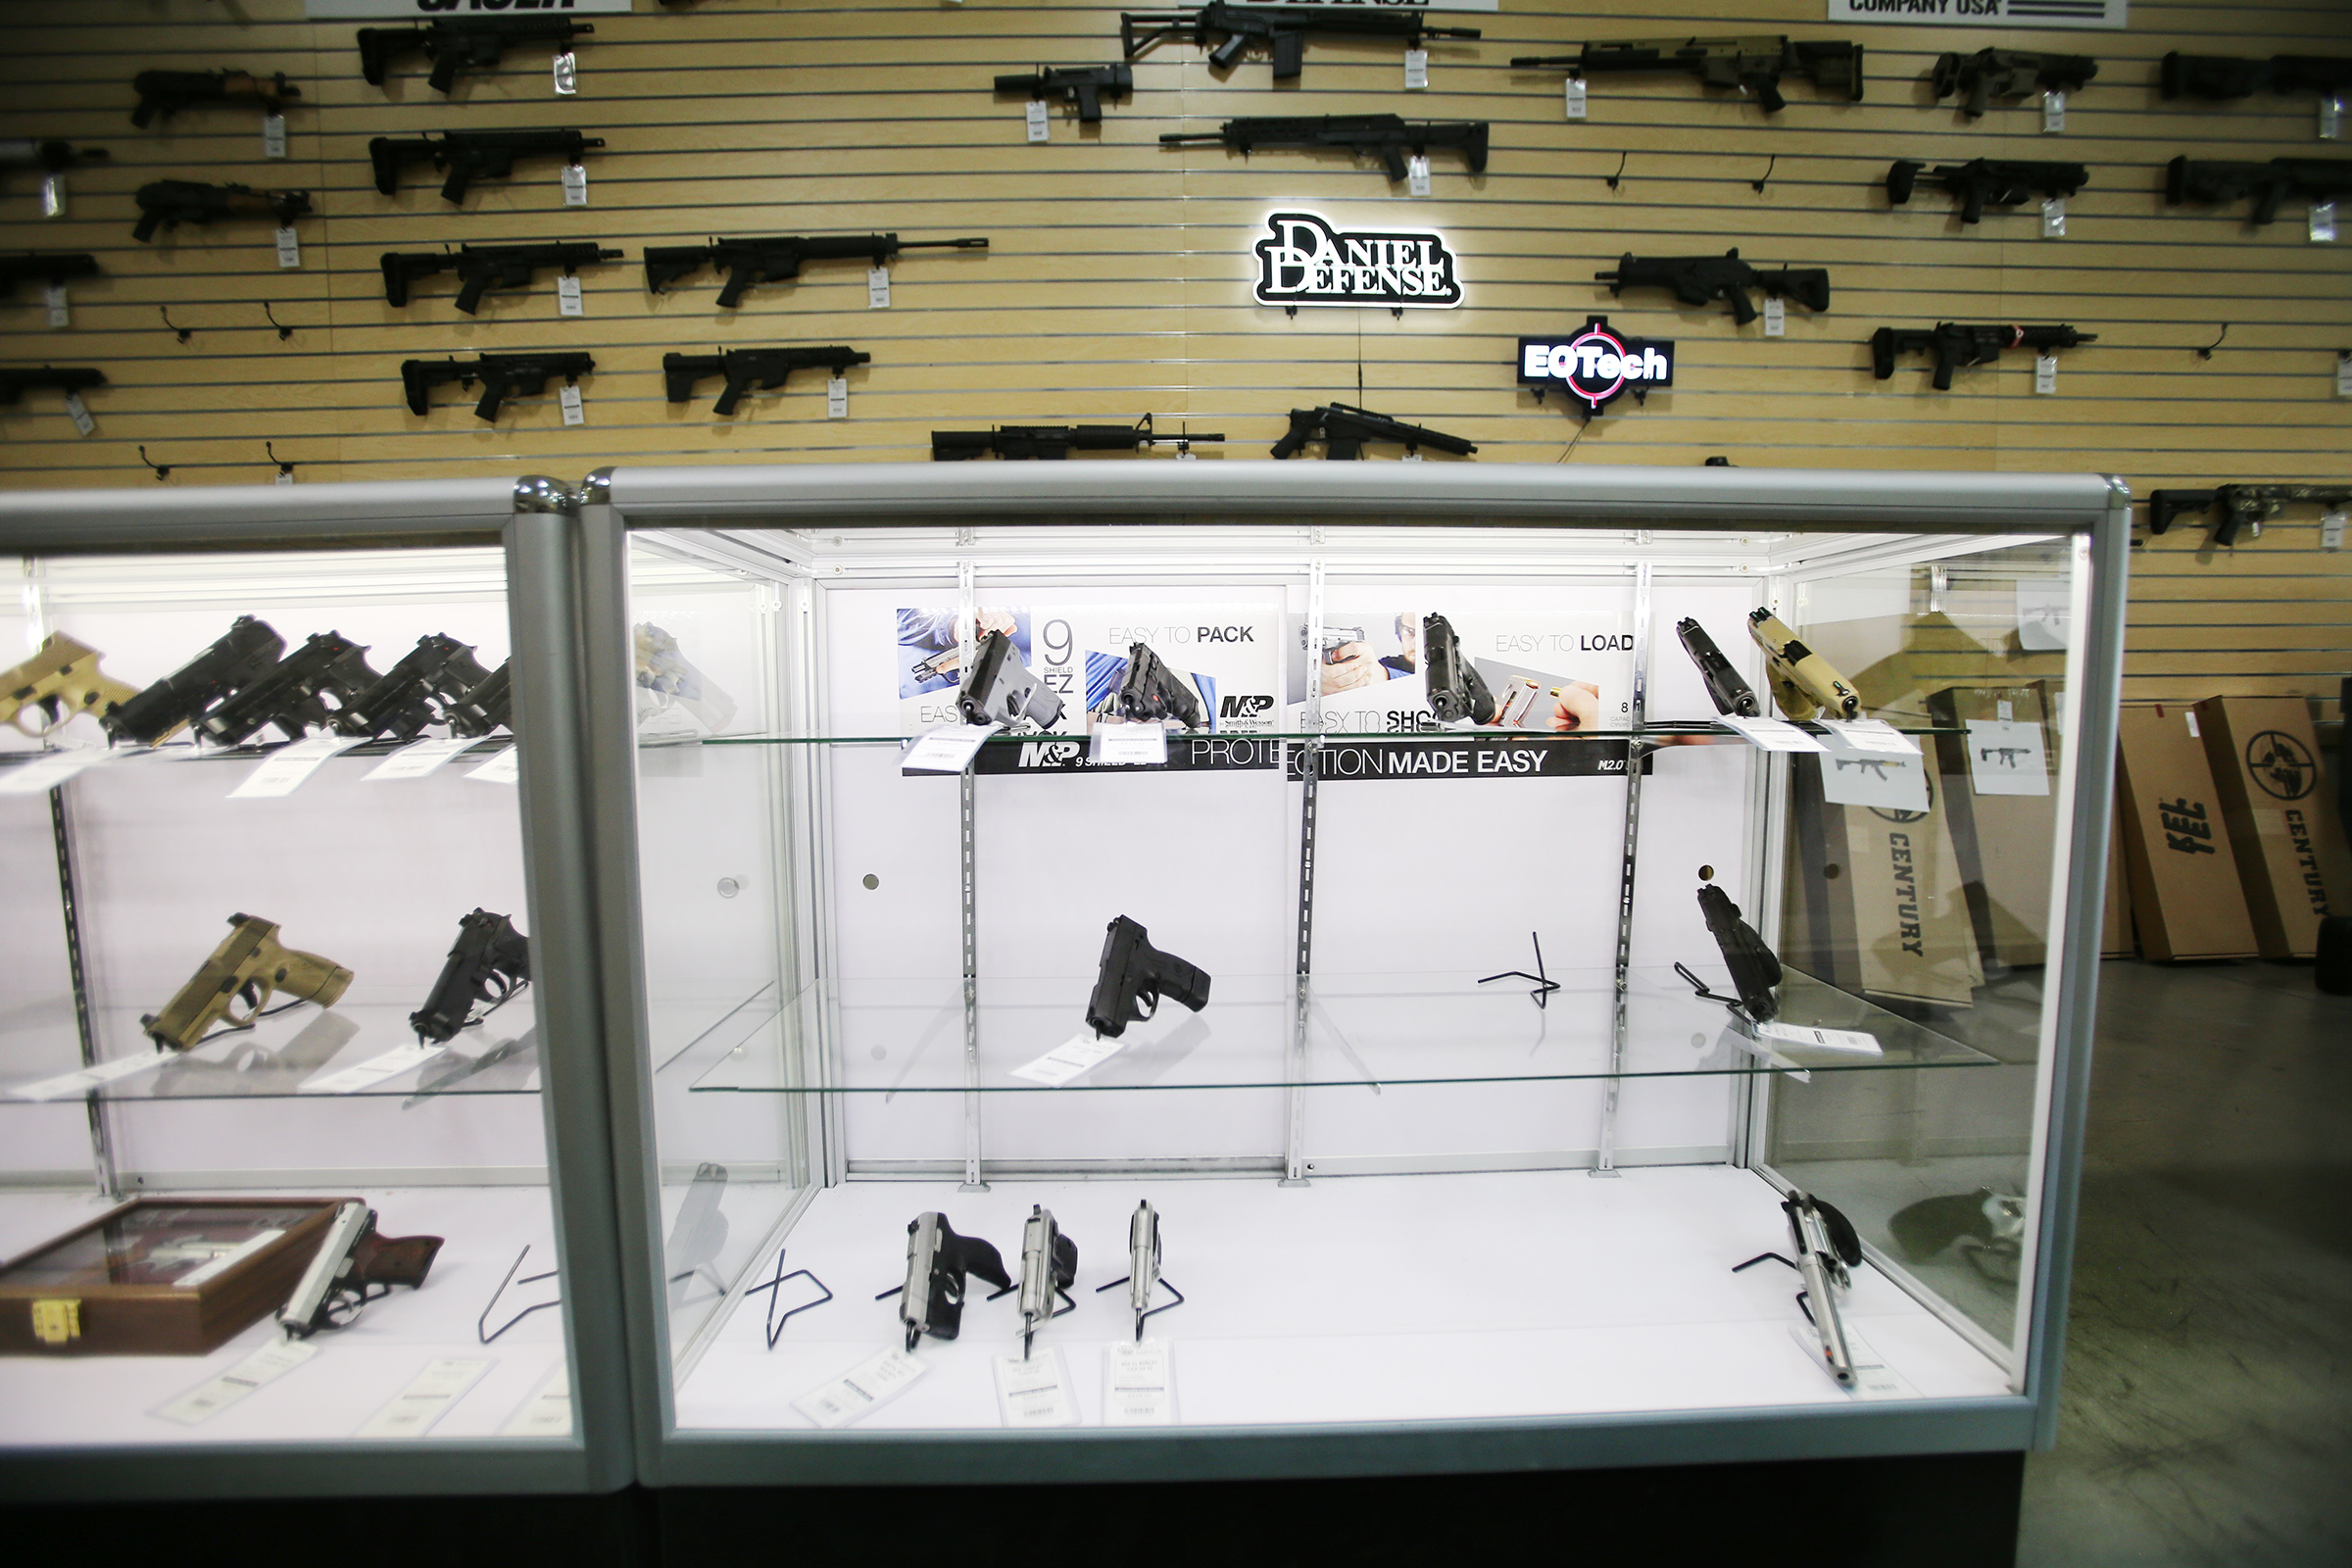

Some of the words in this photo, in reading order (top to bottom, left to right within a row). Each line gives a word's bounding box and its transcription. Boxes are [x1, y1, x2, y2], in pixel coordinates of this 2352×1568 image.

[1277, 220, 1445, 268] DANIEL
[1524, 345, 1667, 380] EOTech
[1043, 619, 1073, 666] 9
[1109, 627, 1159, 644] EASY
[1164, 626, 1191, 644] TO
[1198, 626, 1254, 643] PACK
[1496, 635, 1544, 652] EASY
[1549, 635, 1574, 652] TO
[1581, 635, 1634, 652] LOAD
[1044, 674, 1074, 694] EZ
[921, 706, 957, 723] EAS
[1220, 695, 1274, 718] M&P
[1354, 710, 1381, 724] TO
[1387, 710, 1439, 724] SHO
[1018, 742, 1080, 767] M&P
[1075, 757, 1084, 767] 9
[1389, 752, 1469, 774] MADE
[1477, 750, 1547, 773] EASY
[2284, 809, 2331, 916] CENTURY
[1889, 832, 1924, 956] CENTURY
